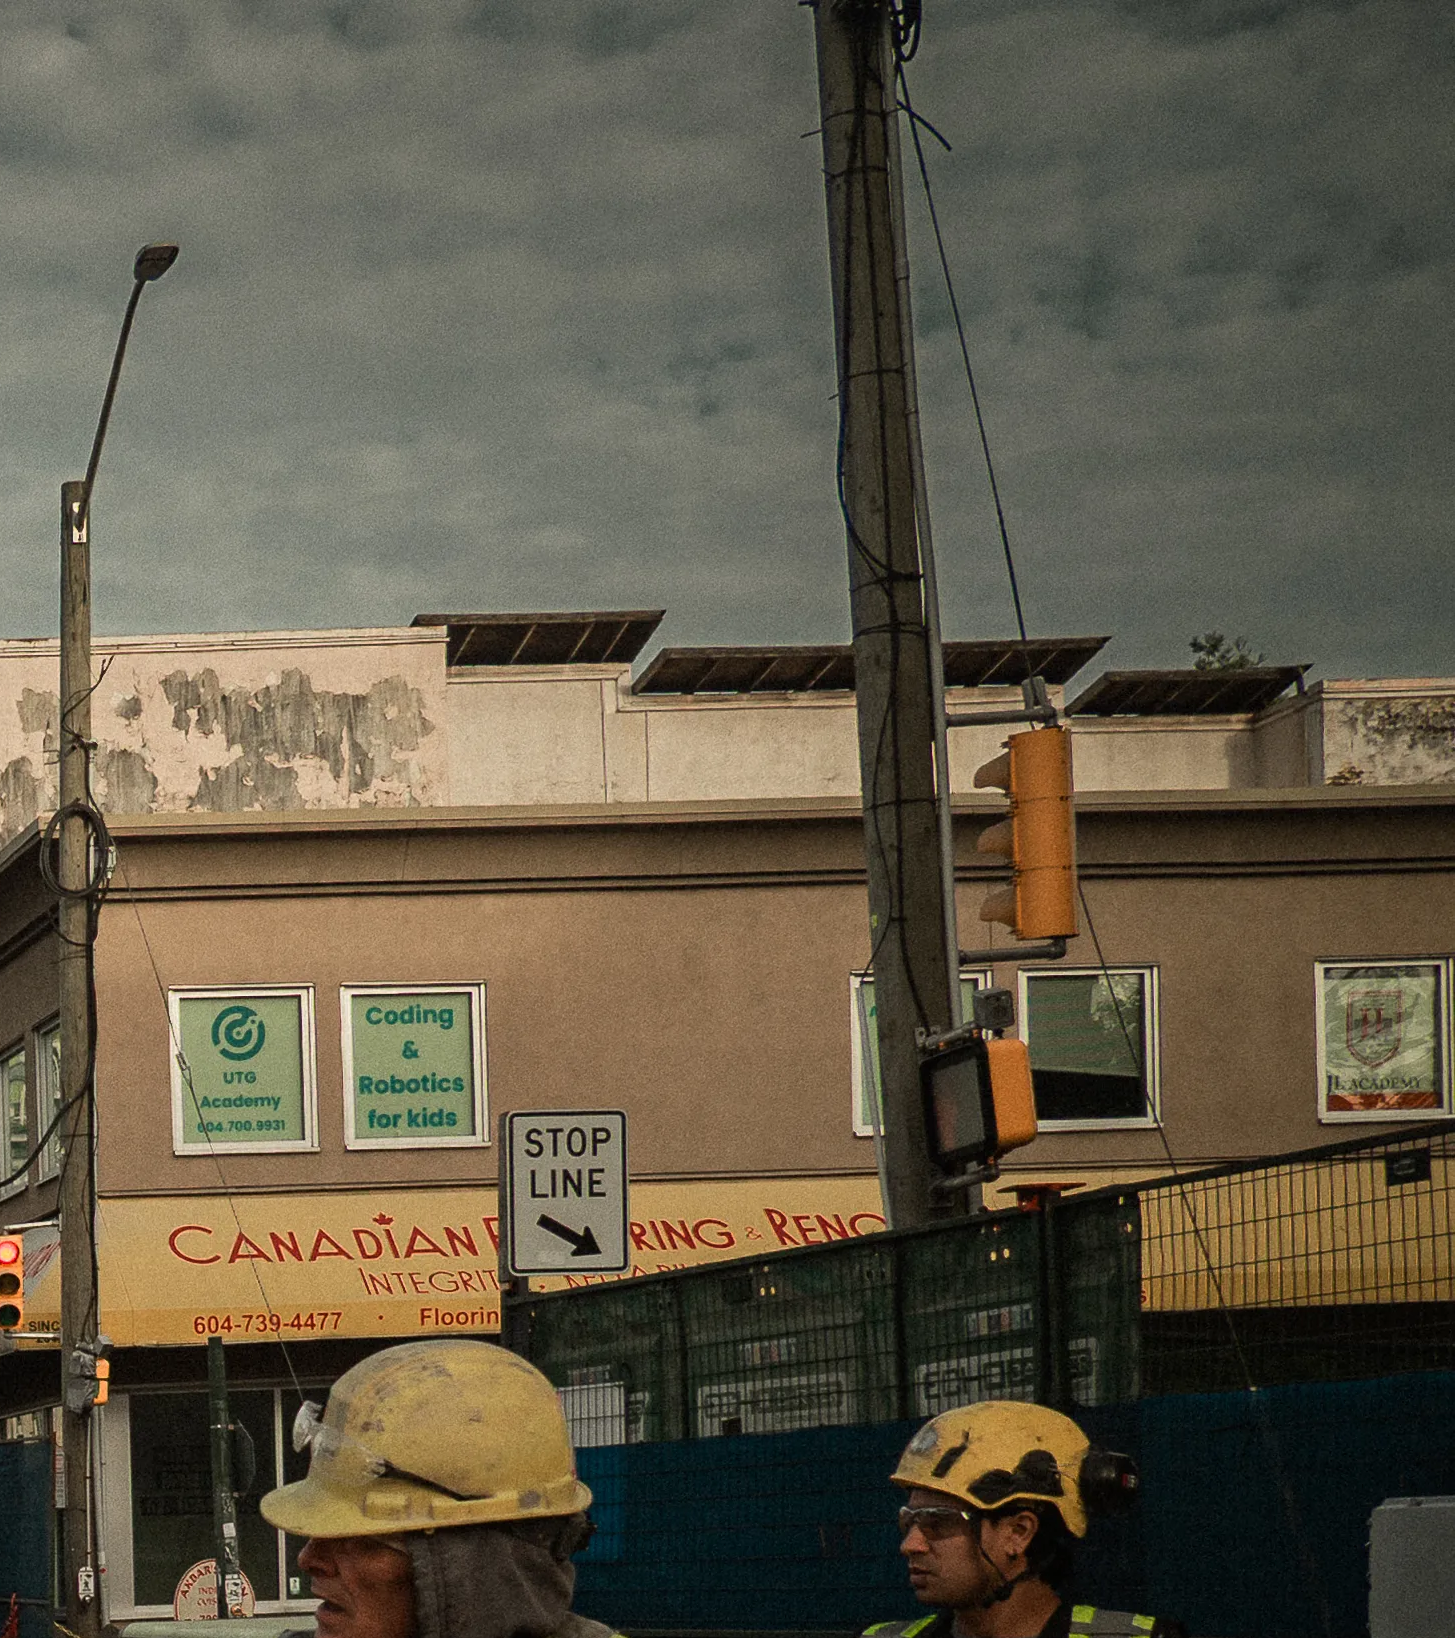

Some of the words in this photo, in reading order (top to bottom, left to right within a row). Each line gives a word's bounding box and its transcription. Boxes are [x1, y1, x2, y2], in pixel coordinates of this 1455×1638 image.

[365, 1004, 454, 1030] Coding
[401, 1040, 419, 1060] &
[222, 1071, 257, 1085] UTG
[358, 1072, 465, 1095] Robotics
[1349, 1077, 1421, 1090] ACADEMY
[200, 1095, 281, 1111] Academy
[197, 1119, 286, 1133] 604.700.9931
[368, 1108, 401, 1129] for
[407, 1106, 457, 1128] kids
[524, 1126, 612, 1158] STOP
[530, 1168, 606, 1199] LINE
[168, 1223, 489, 1265] CANADIAN
[744, 1226, 763, 1243] &
[358, 1267, 501, 1296] INTEGRIT
[28, 1320, 60, 1332] SINC
[193, 1311, 343, 1335] 604-739-4477
[419, 1307, 499, 1328] Floorin
